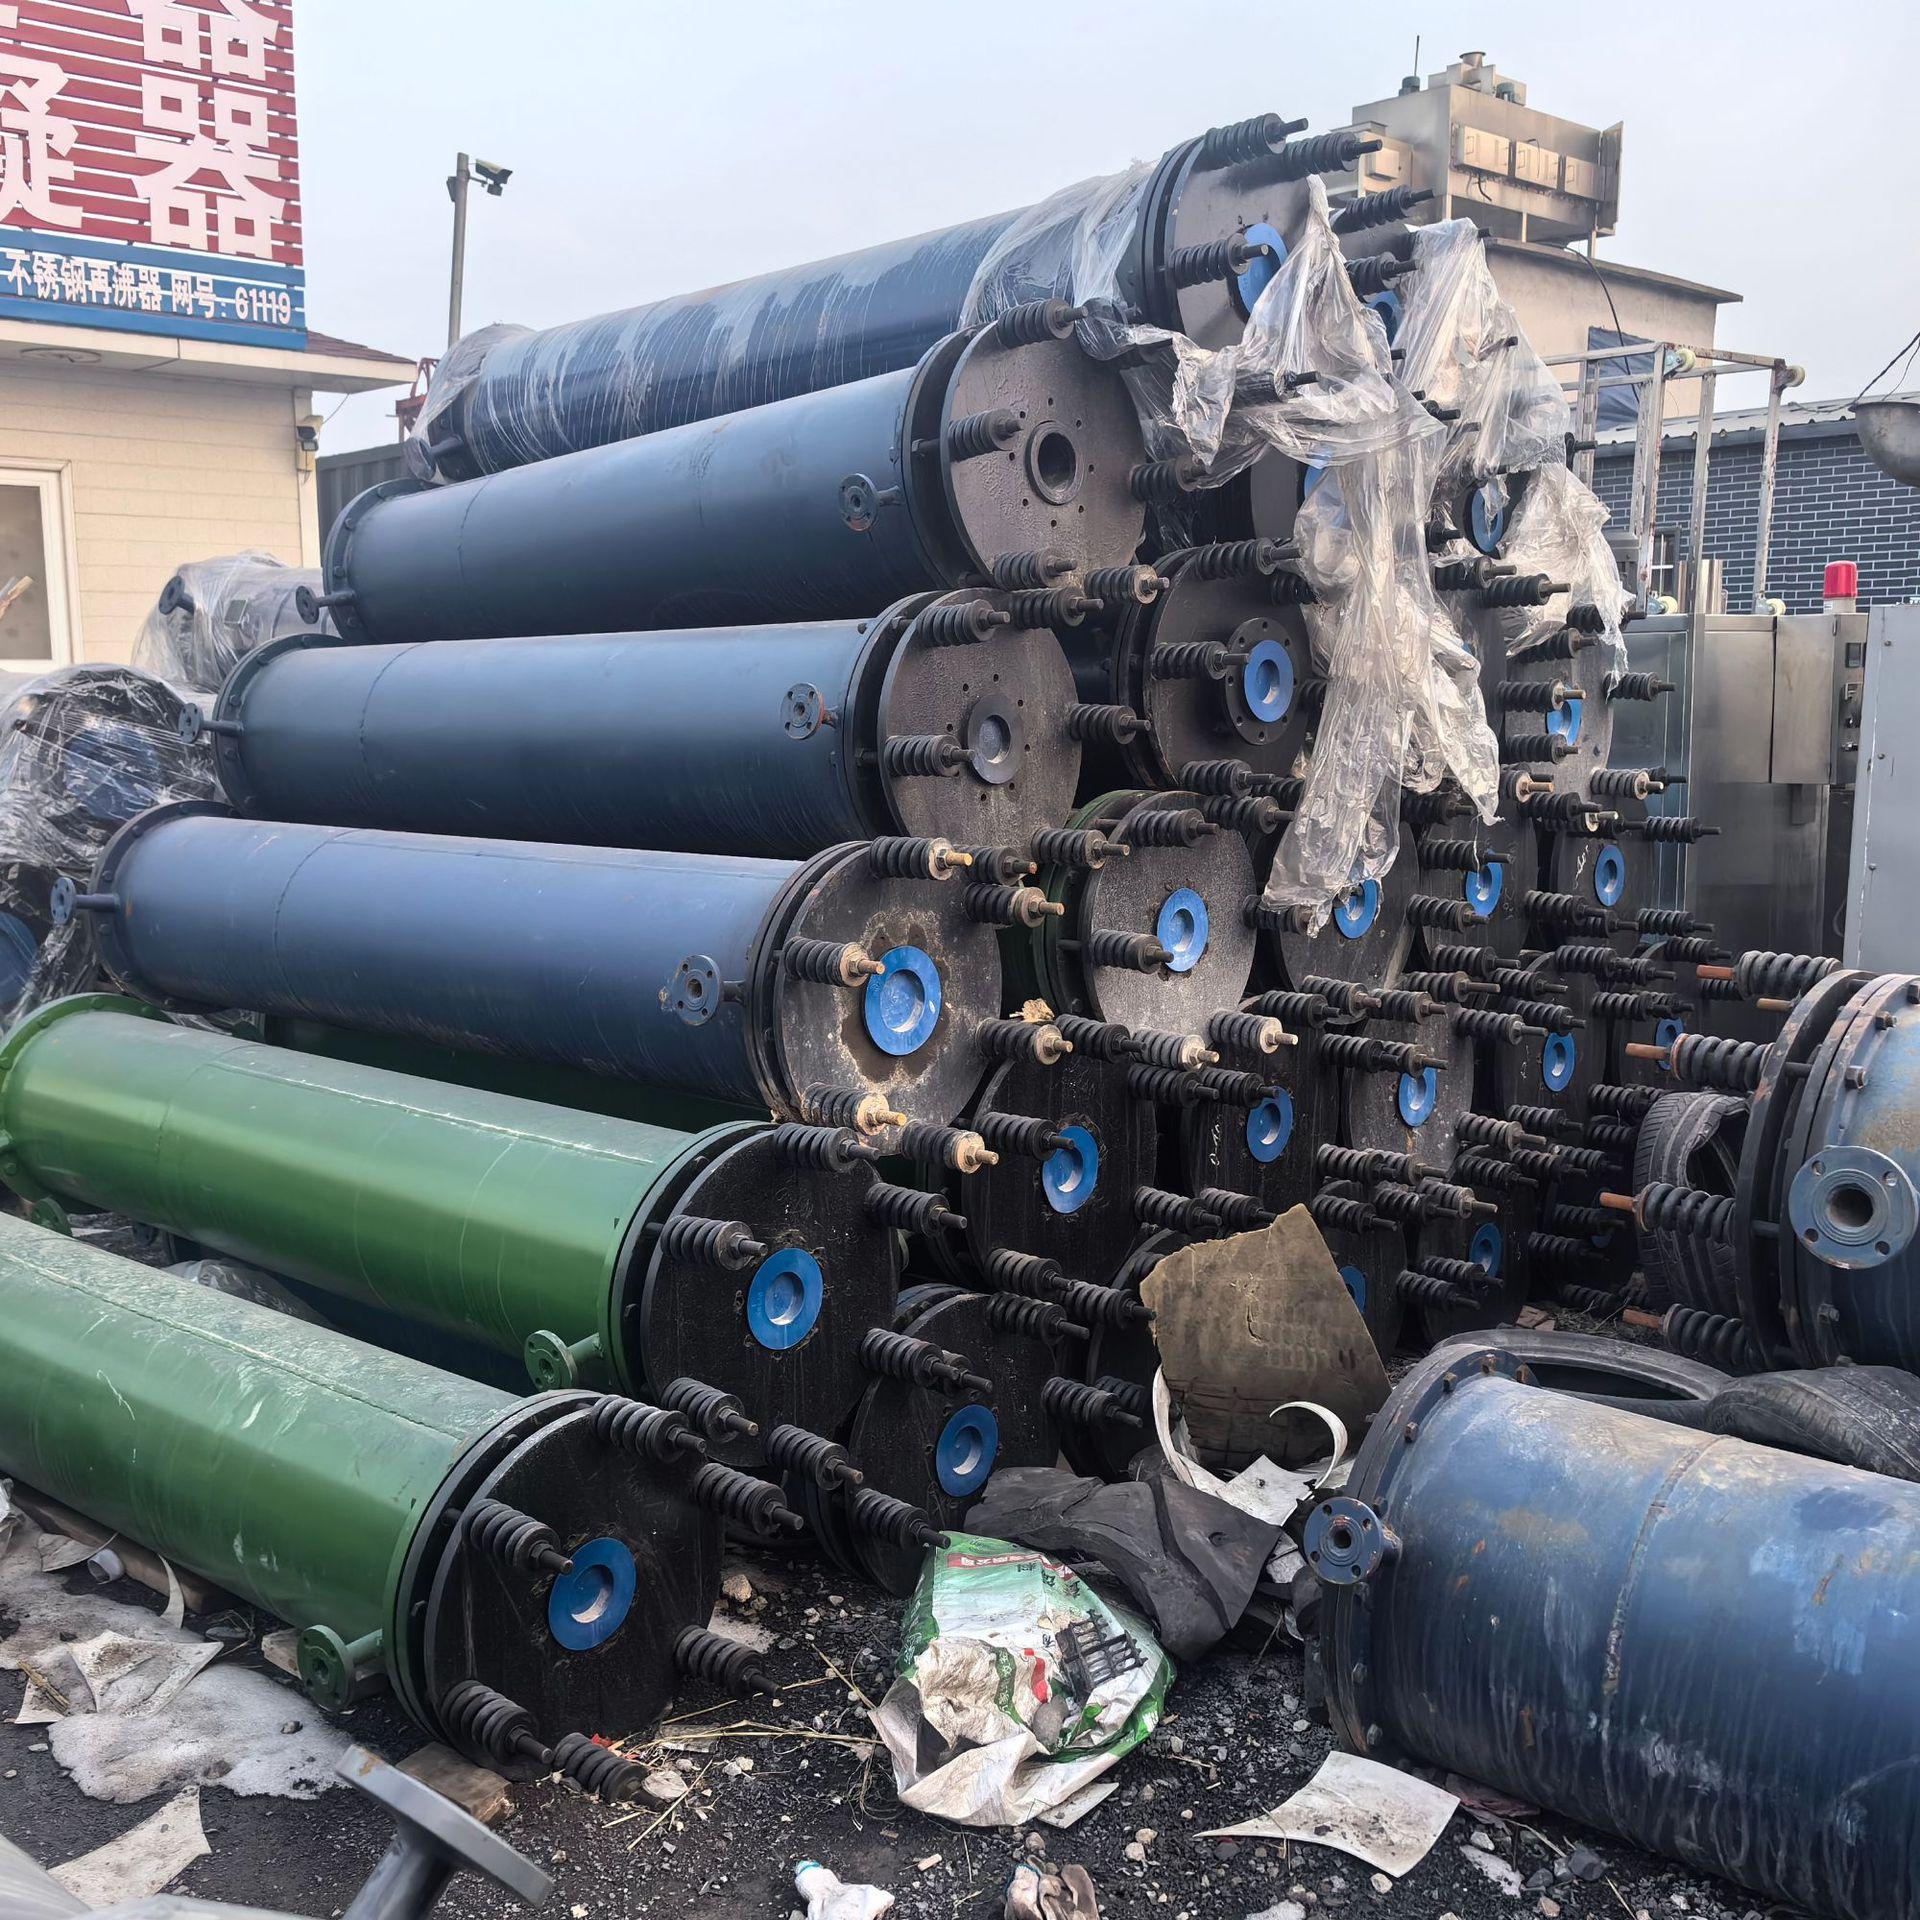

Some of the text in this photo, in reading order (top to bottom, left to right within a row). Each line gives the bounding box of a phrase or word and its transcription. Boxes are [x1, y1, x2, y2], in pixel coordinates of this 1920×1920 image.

[6, 250, 163, 312] 不锈钢再沸器
